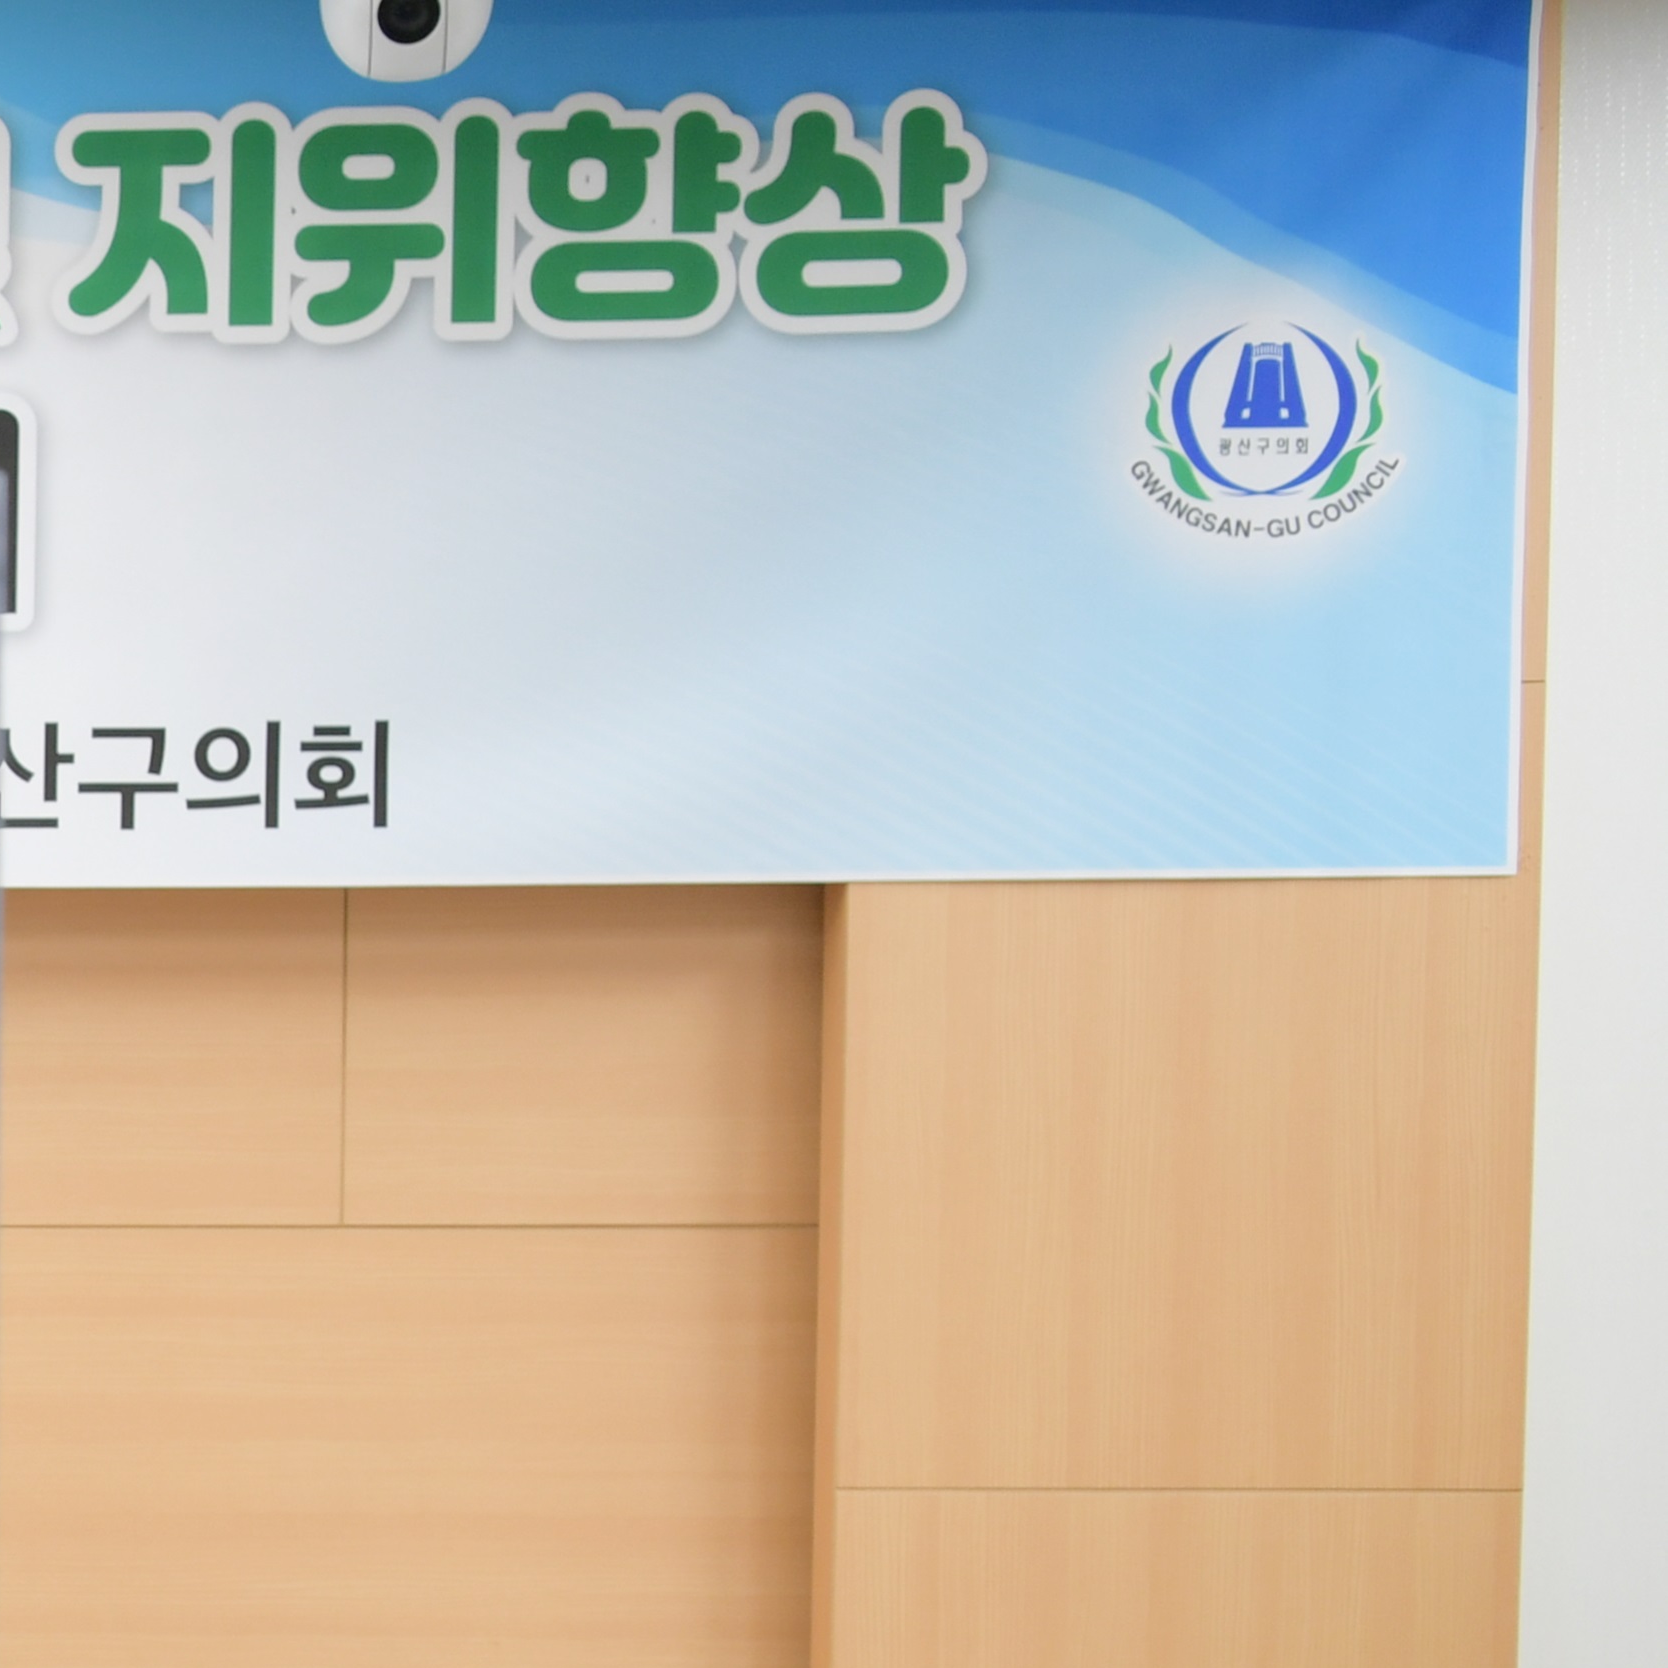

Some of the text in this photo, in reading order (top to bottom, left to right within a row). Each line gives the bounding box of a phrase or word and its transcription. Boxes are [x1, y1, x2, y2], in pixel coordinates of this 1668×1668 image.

[67, 100, 971, 328] 지위향상
[1130, 455, 1399, 538] GWANGSAN-GU COUNCIL
